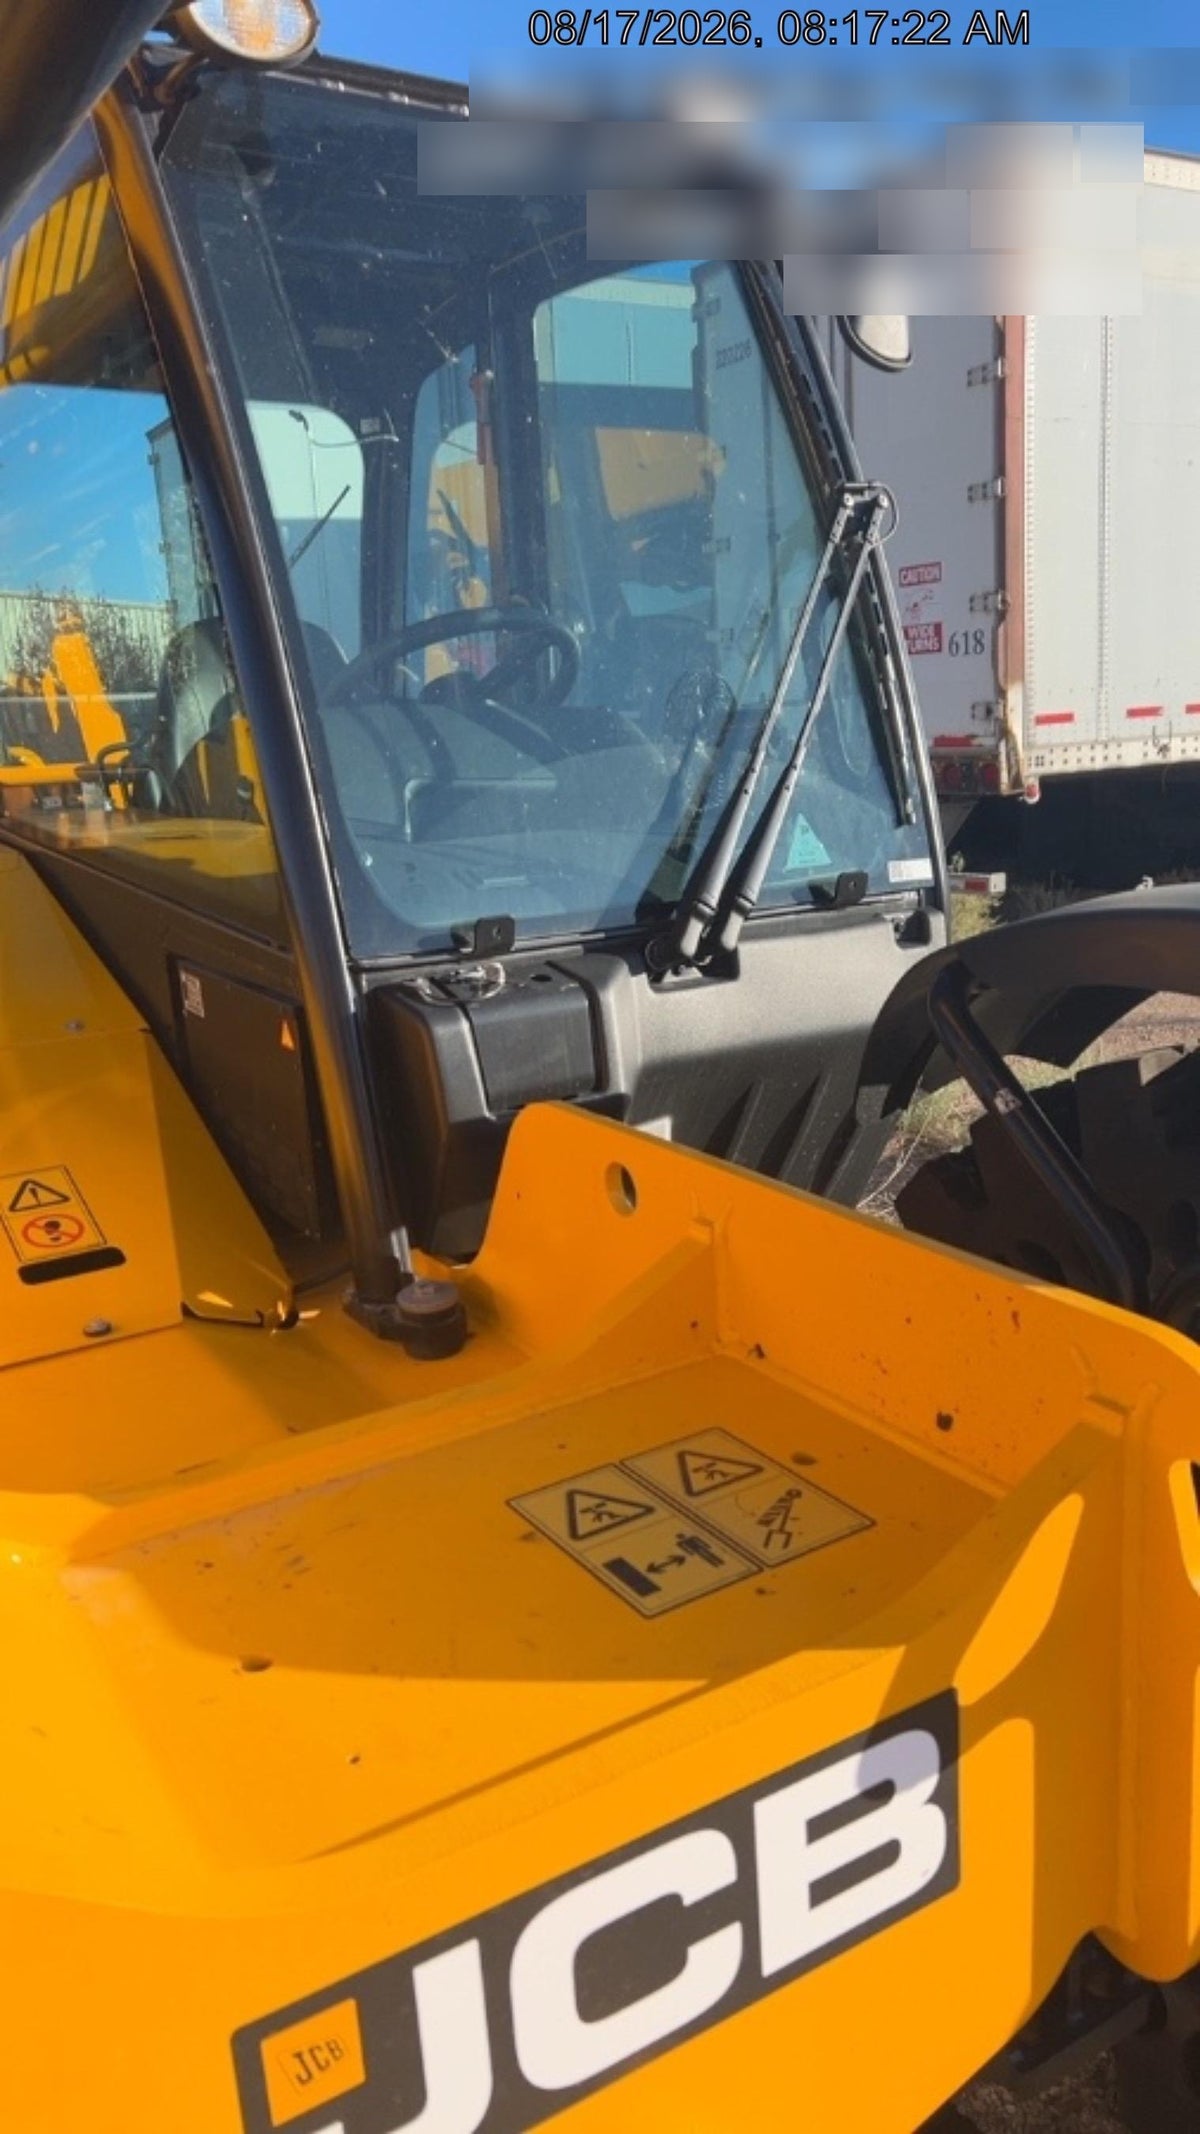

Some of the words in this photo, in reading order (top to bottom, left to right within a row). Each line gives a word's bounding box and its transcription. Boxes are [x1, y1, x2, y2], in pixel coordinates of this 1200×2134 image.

[901, 564, 940, 585] CAUTION
[907, 625, 934, 640] WIDE
[948, 628, 986, 657] 618
[310, 1728, 948, 2134] JCB
[292, 2038, 345, 2086] JCB
